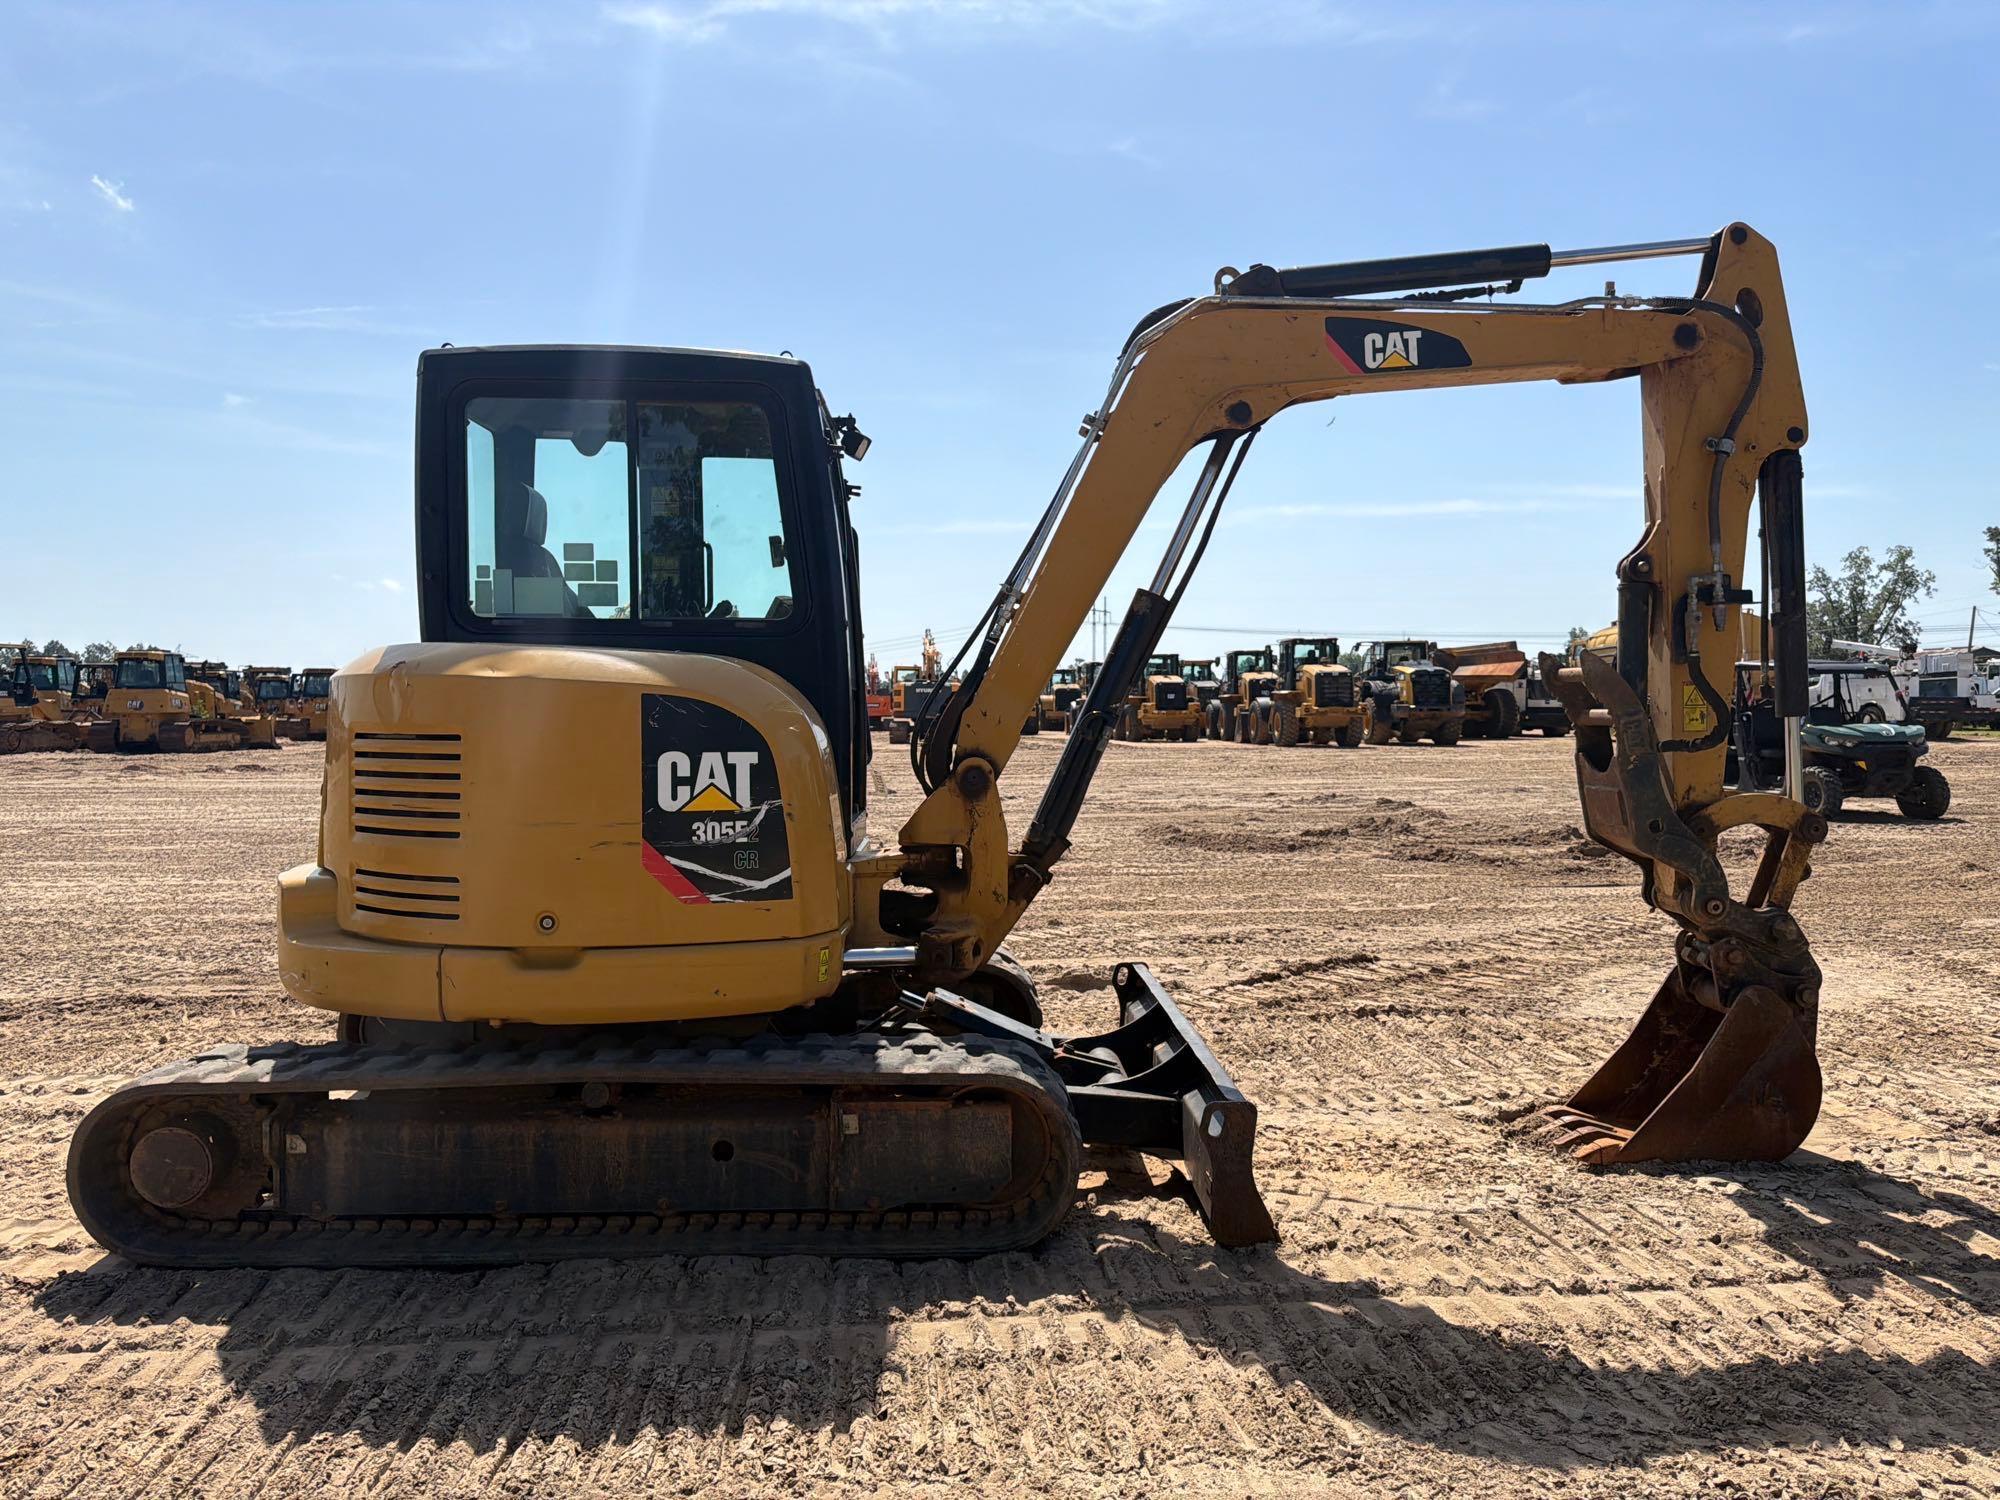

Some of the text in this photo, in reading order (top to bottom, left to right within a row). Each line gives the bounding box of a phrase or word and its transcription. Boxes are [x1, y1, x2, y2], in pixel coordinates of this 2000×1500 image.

[1364, 331, 1421, 369] CAT
[657, 751, 759, 812] CAT
[734, 850, 759, 869] CR
